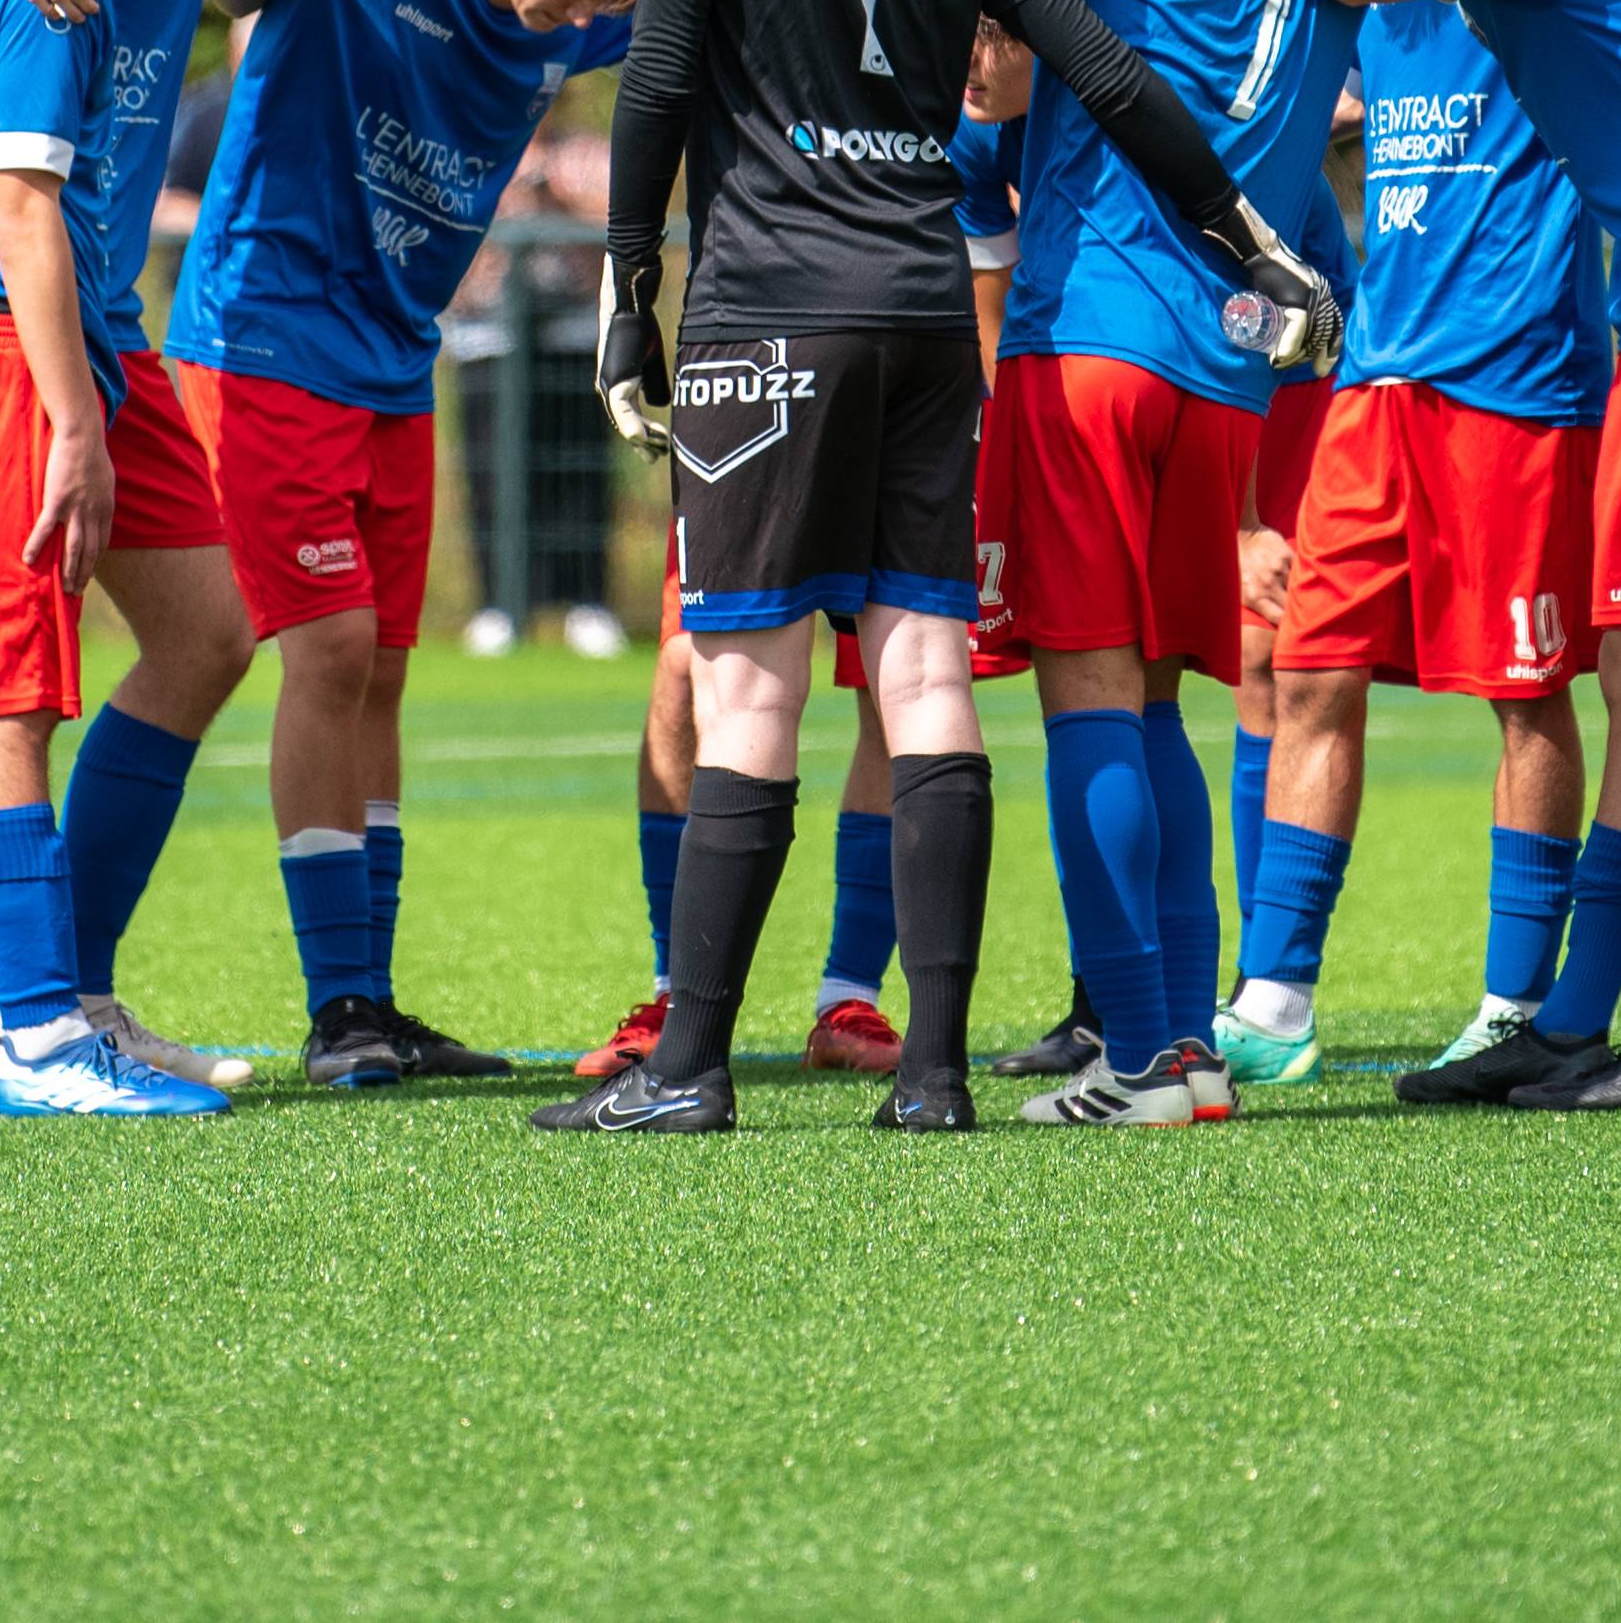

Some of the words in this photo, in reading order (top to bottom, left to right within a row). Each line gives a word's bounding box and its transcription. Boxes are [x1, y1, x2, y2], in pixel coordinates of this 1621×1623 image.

[394, 1, 454, 43] uhlsport
[355, 105, 497, 190] L'ENTRACT
[821, 126, 952, 163] POLYGO
[361, 147, 474, 217] HENNEBONT
[978, 542, 1006, 607] 7
[1509, 591, 1568, 661] 10
